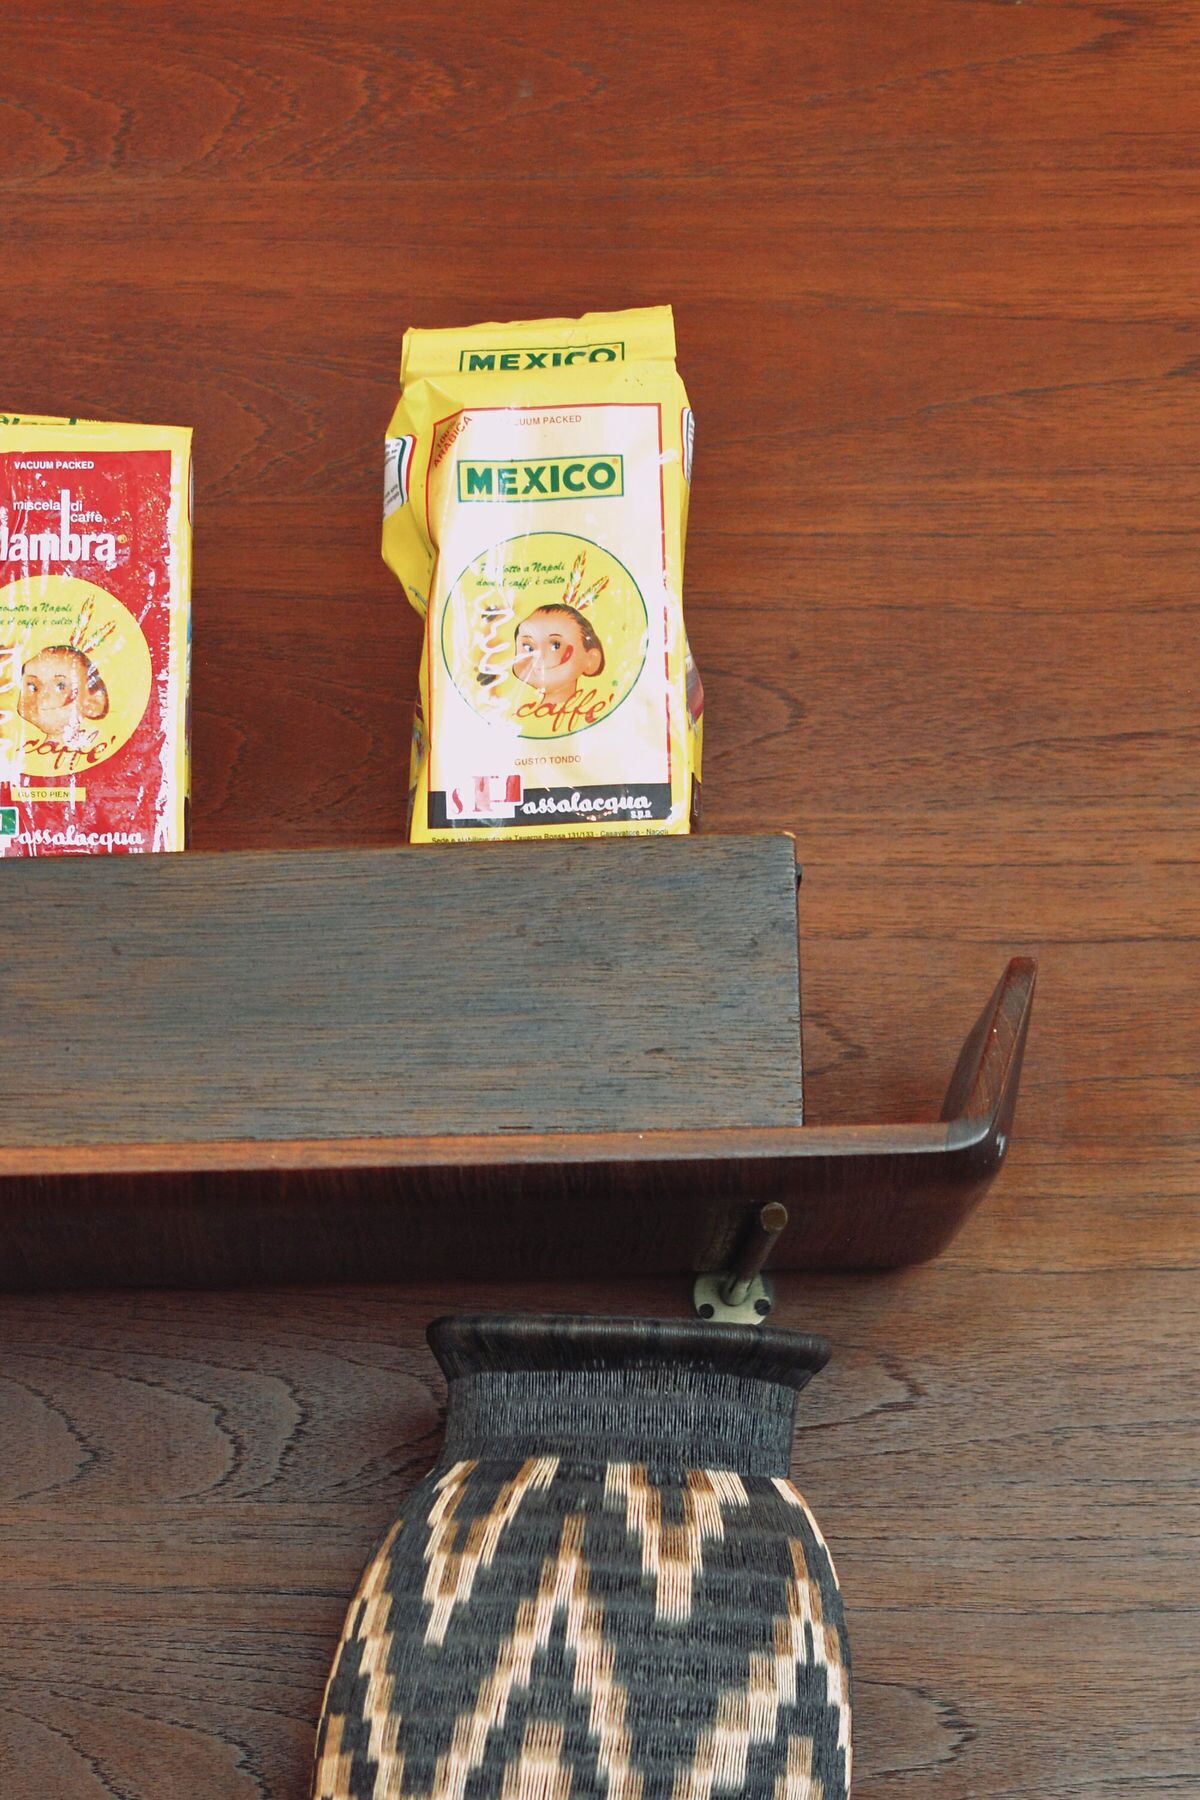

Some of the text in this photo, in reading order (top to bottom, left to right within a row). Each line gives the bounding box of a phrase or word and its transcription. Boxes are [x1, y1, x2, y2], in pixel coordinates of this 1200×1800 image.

[468, 348, 616, 372] MEXICO
[543, 415, 582, 424] PACKED
[14, 461, 95, 470] VACUUM PACKED
[467, 462, 616, 495] MEXICO
[13, 499, 83, 511] miscela di
[70, 511, 103, 523] caffè
[531, 561, 565, 573] Napoli
[40, 602, 72, 614] Napoli
[515, 755, 582, 766] GUSTO TONDO
